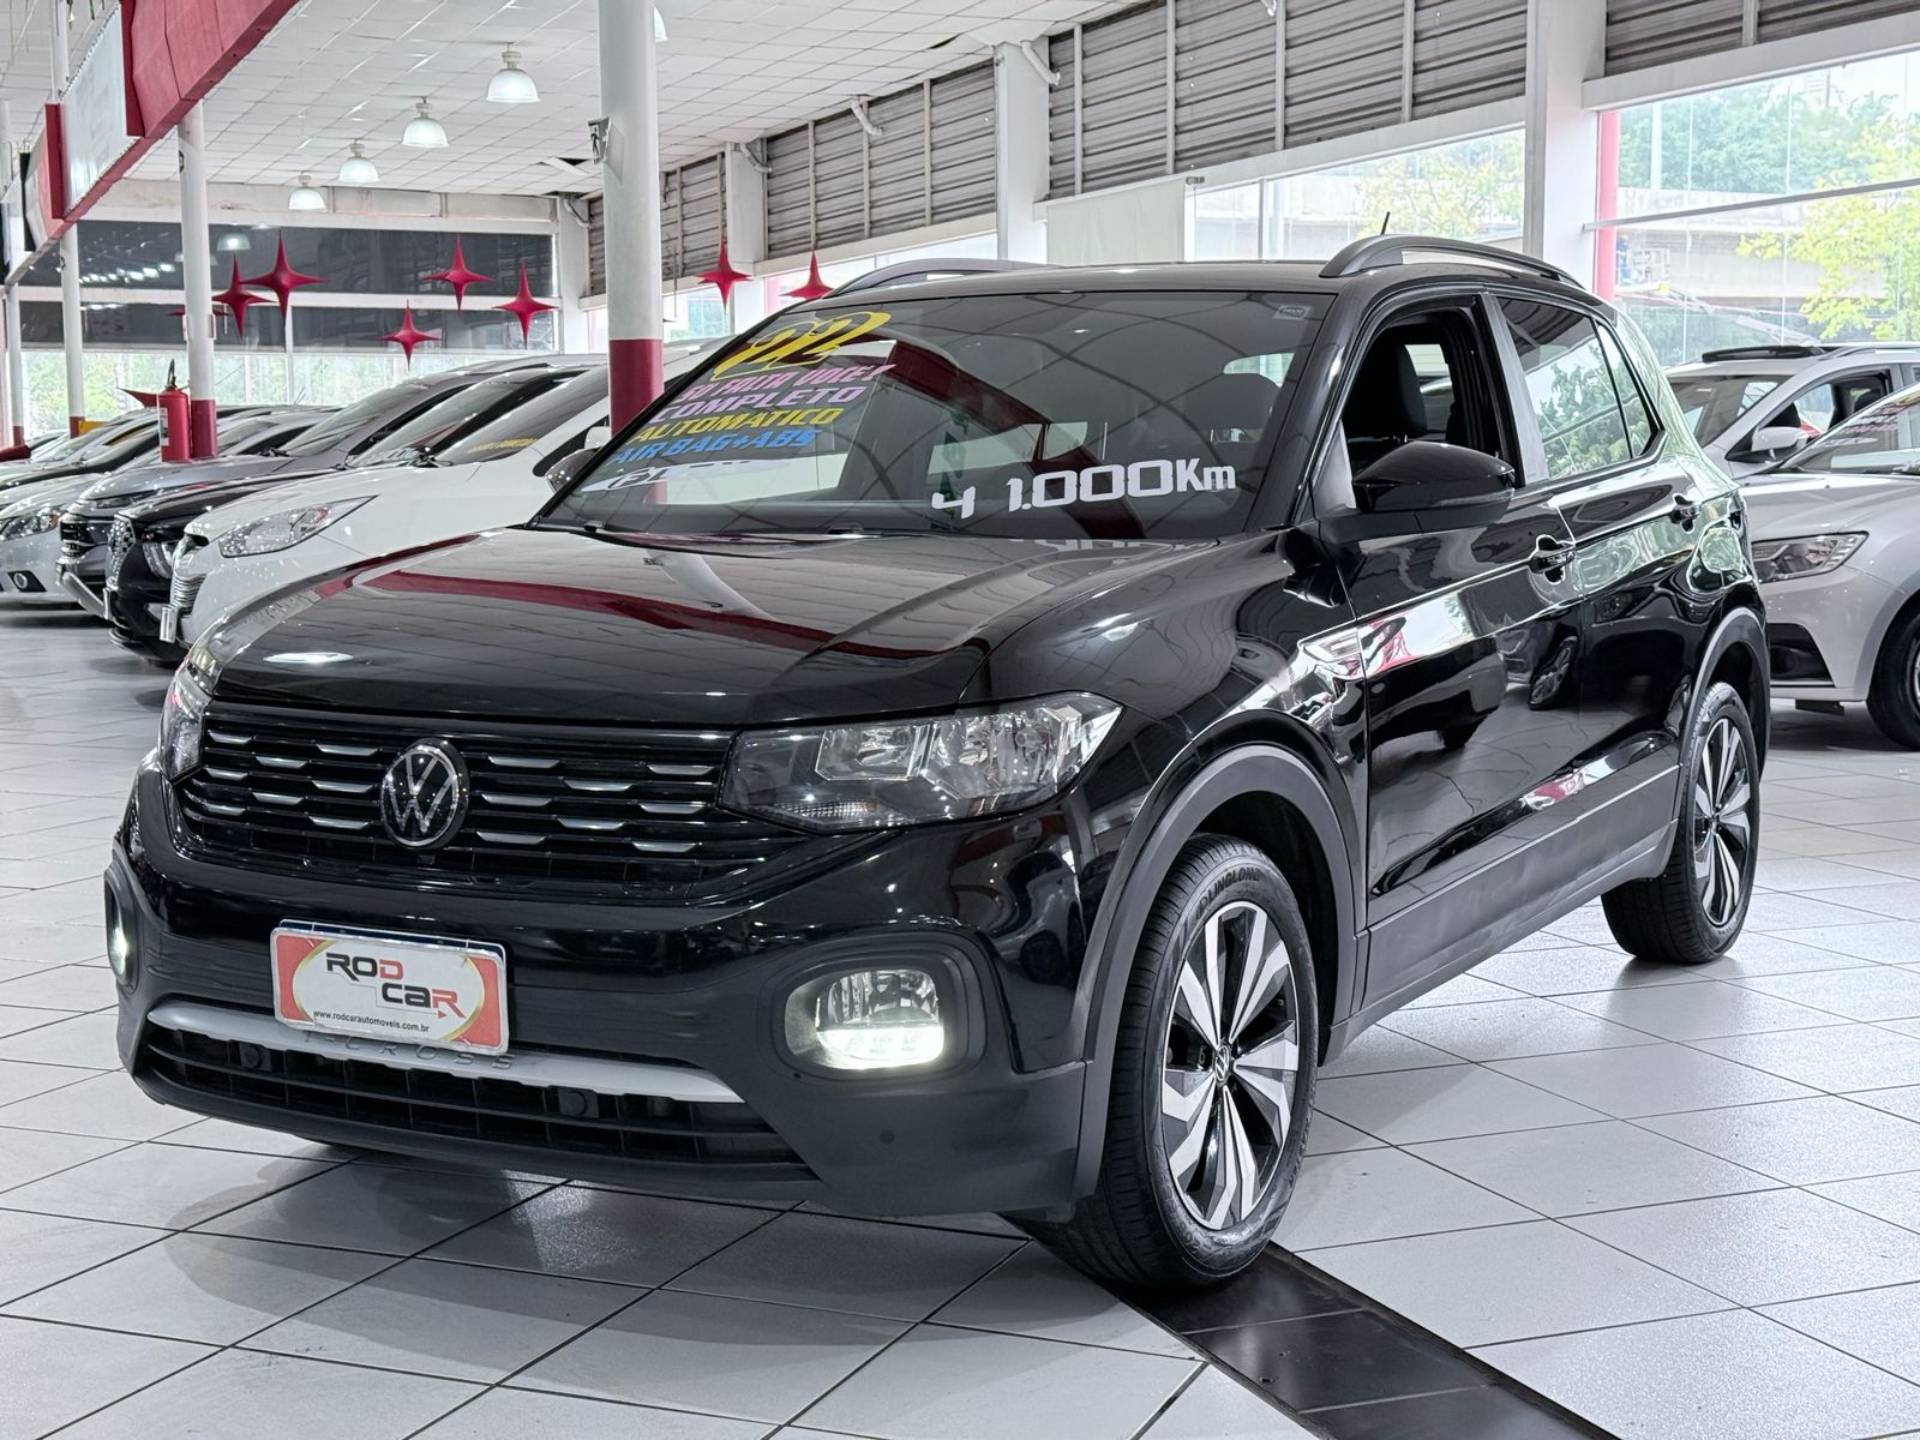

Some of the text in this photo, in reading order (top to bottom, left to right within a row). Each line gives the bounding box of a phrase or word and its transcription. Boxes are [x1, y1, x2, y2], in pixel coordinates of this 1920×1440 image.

[709, 311, 892, 382] 22
[648, 386, 868, 424] COMPLETO
[625, 408, 845, 446] AUTOMATICO
[326, 952, 405, 982] ROD
[313, 1010, 431, 1033] www.rodcarautomoveis.com.br
